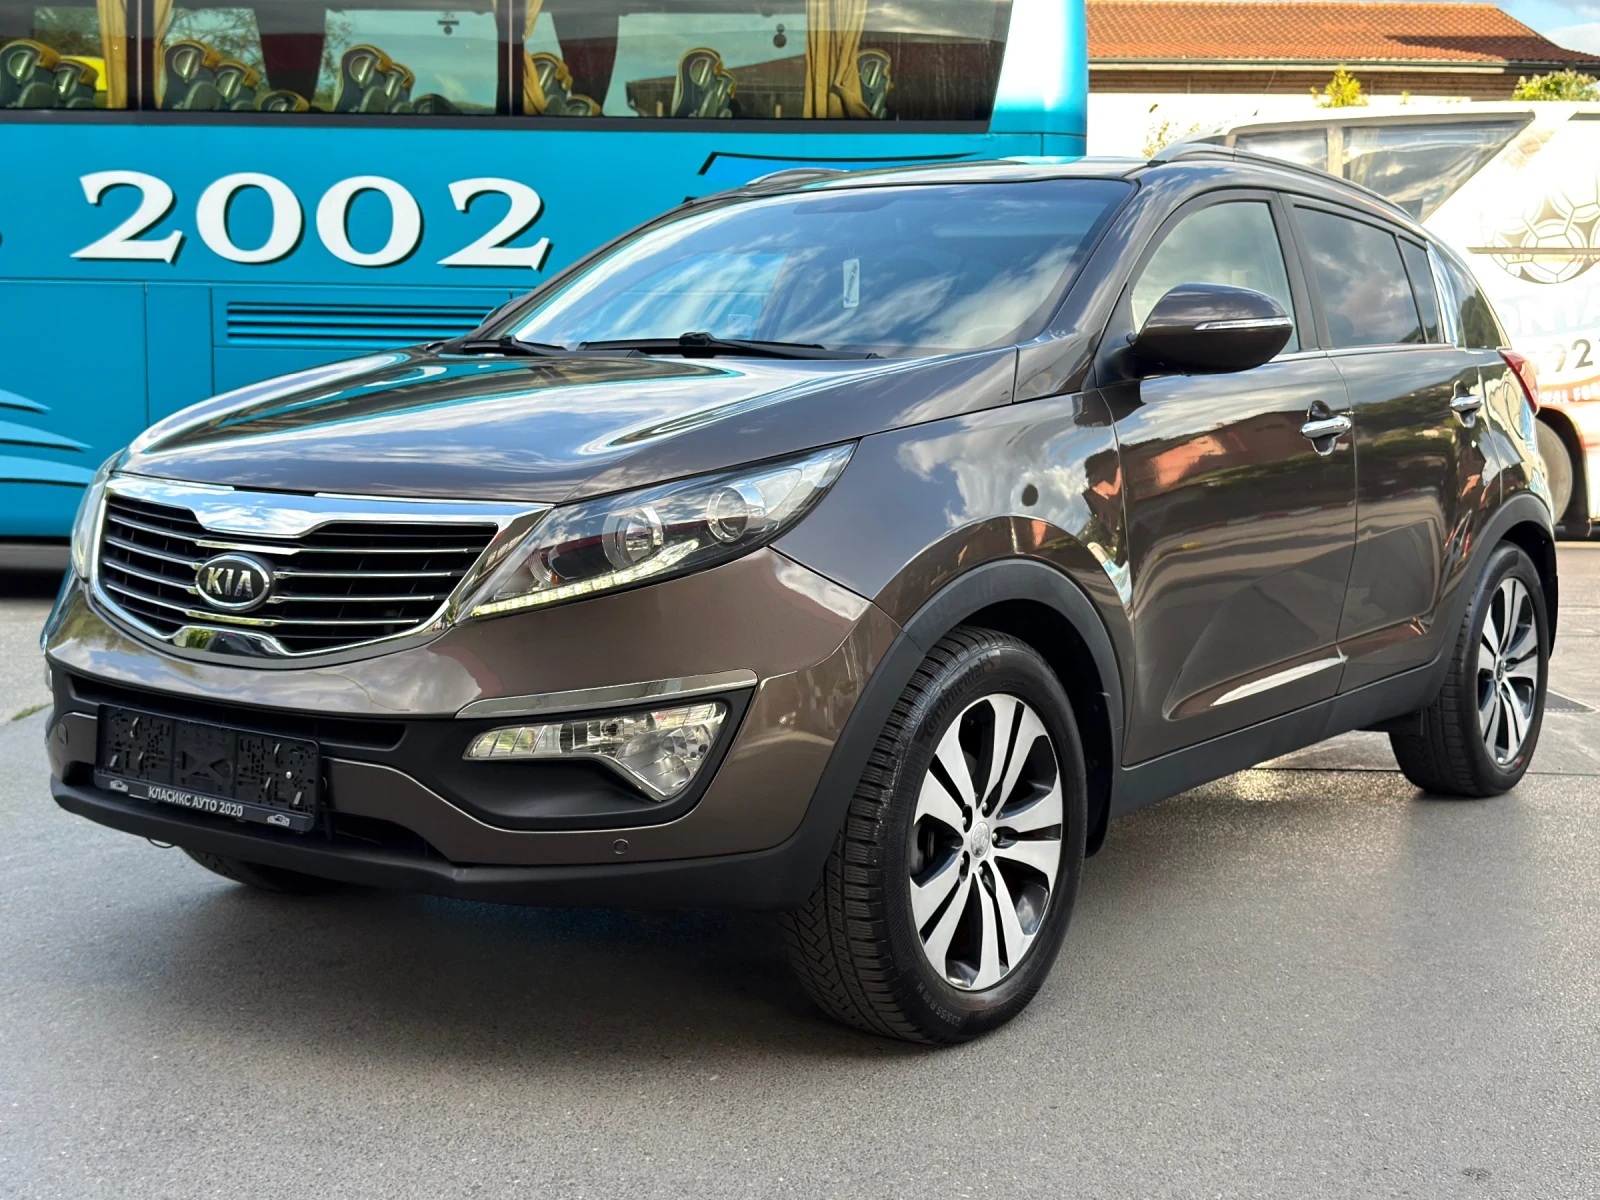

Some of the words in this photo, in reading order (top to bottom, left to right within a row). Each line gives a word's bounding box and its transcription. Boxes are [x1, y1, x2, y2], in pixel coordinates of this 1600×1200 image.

[70, 170, 552, 271] 2002
[206, 567, 254, 597] KIA
[149, 787, 191, 806] КЛАСИКС
[192, 795, 217, 812] АУТО
[219, 802, 243, 817] 2020
